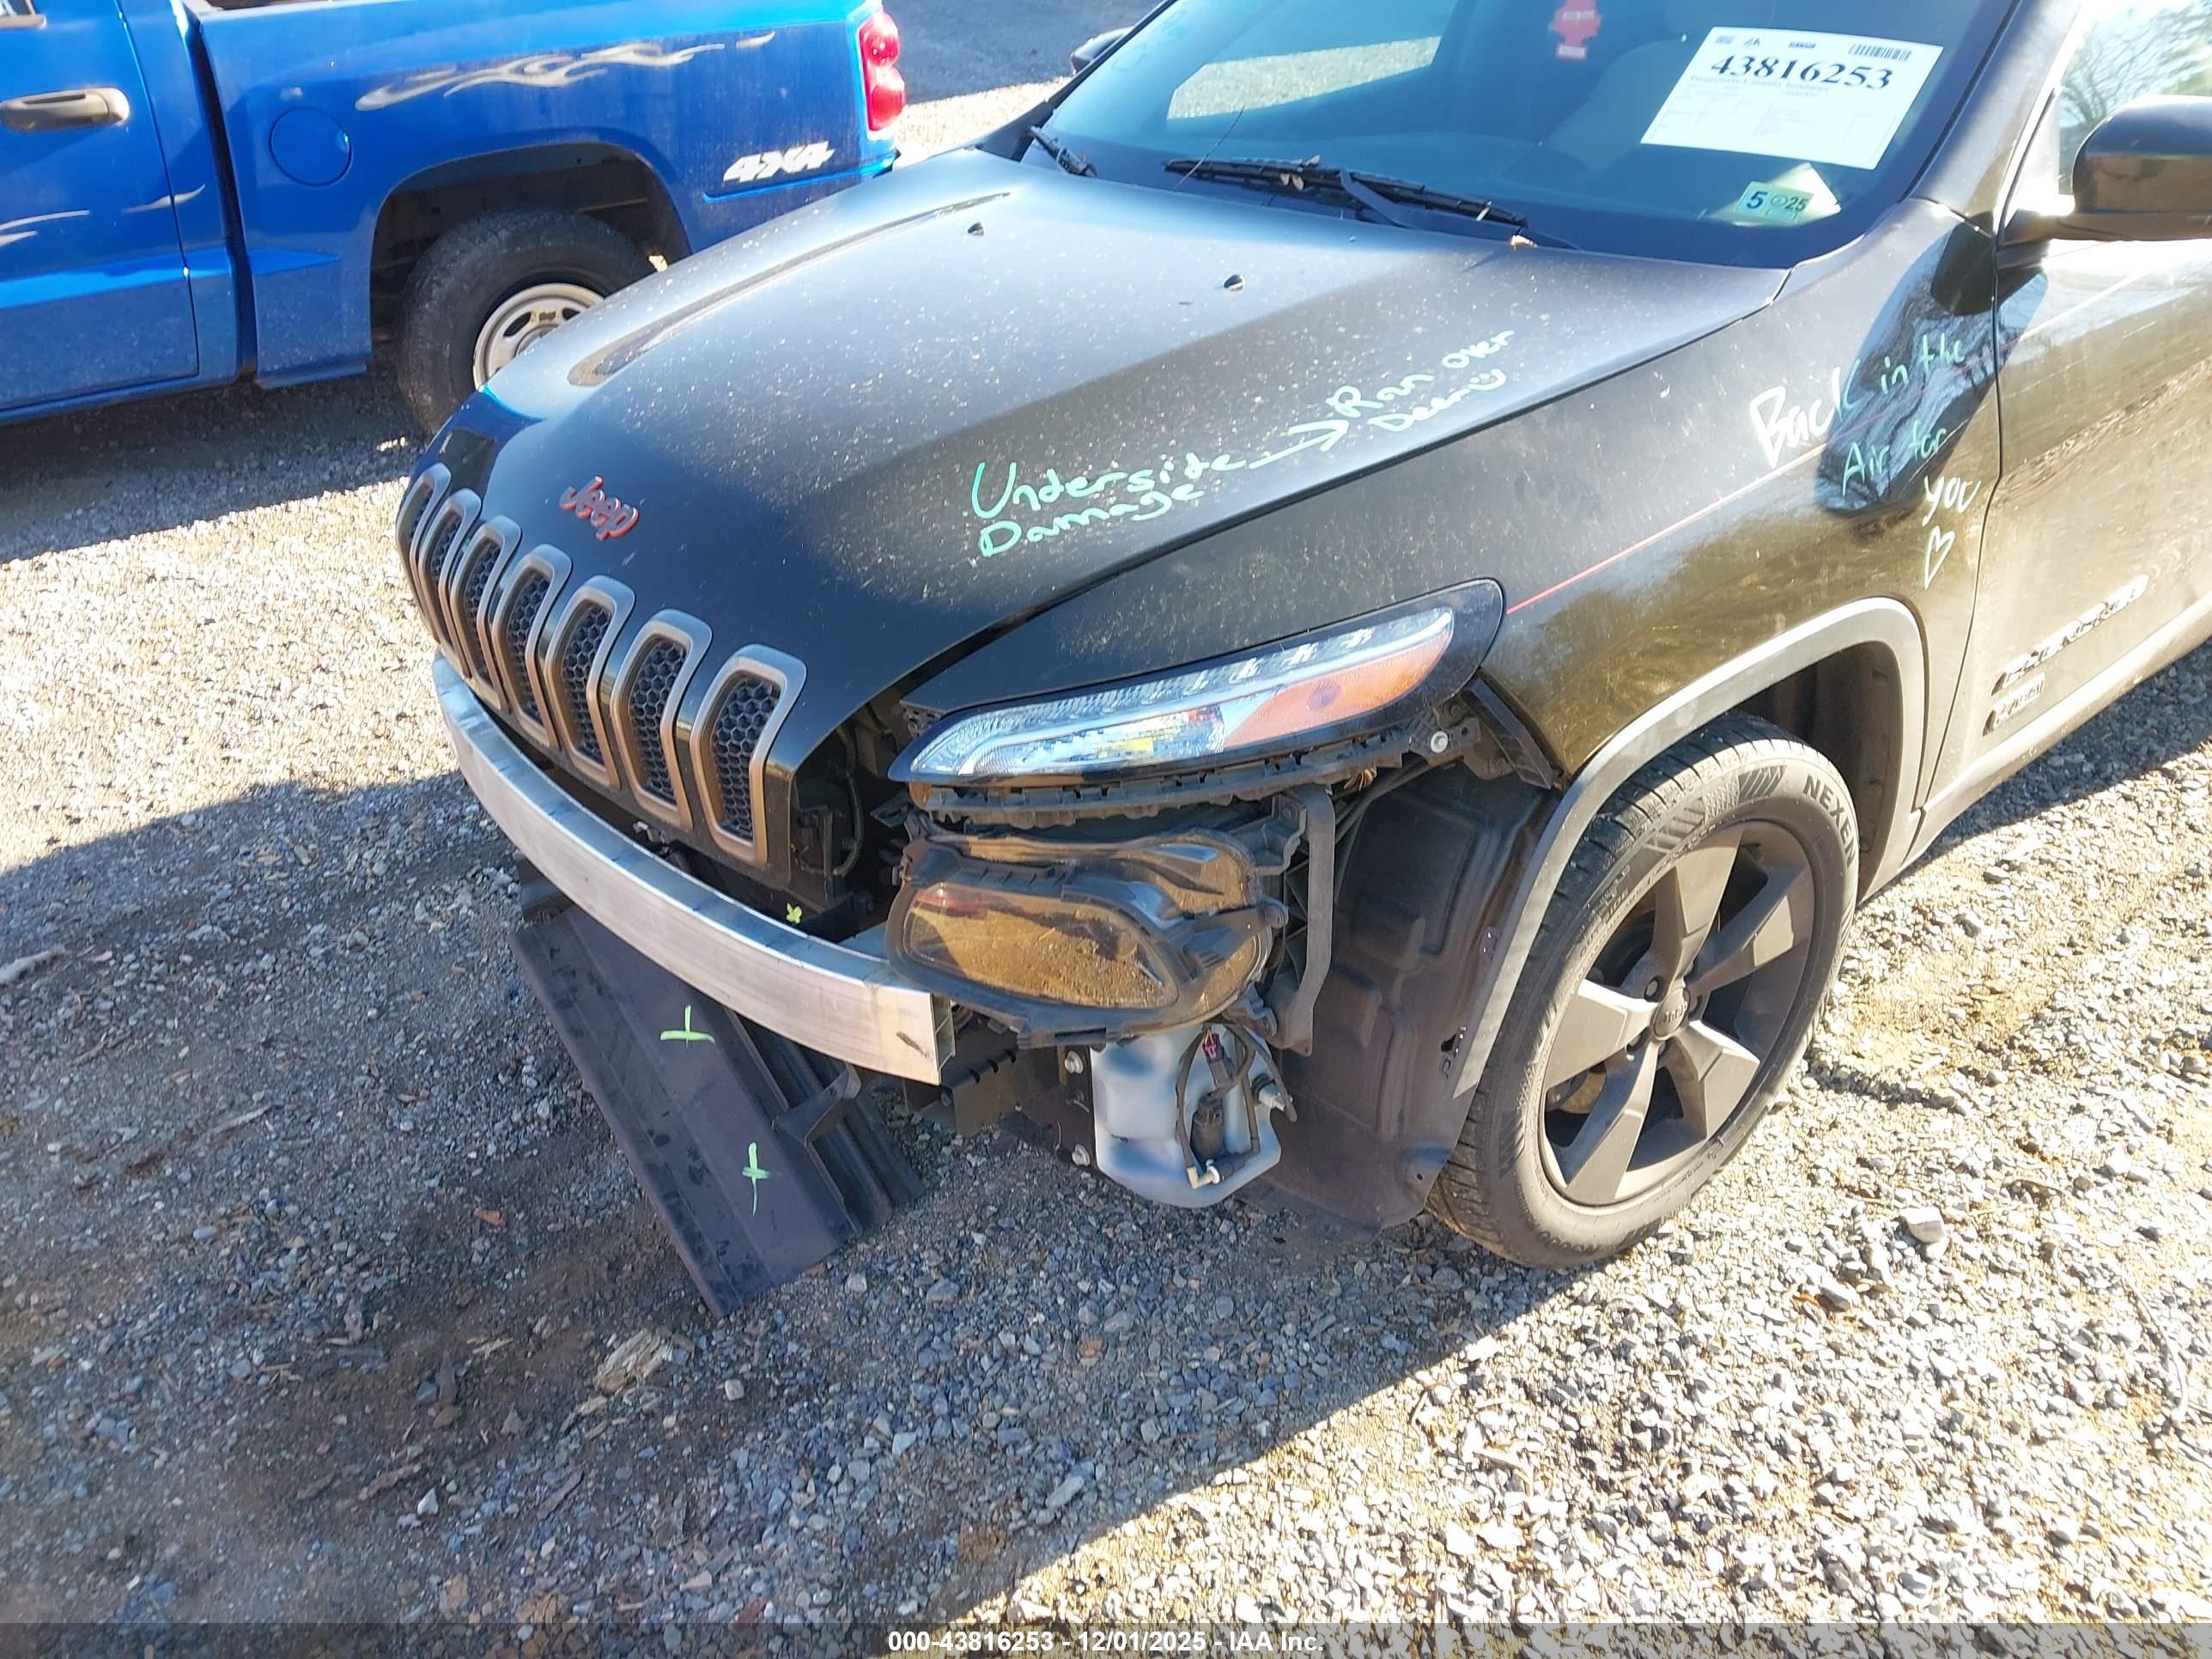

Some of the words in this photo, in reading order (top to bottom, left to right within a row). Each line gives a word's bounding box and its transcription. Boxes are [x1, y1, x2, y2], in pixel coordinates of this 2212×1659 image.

[1711, 54, 1894, 90] 43816253
[1746, 191, 1768, 210] 5
[1784, 197, 1809, 211] 25
[1325, 374, 1434, 417] Ran
[1749, 358, 1861, 468] Back
[1880, 356, 1909, 395] in
[1920, 331, 1966, 366] the
[971, 452, 1247, 519] Underside
[1841, 441, 1890, 496] Air
[558, 475, 639, 541] Jeep
[978, 483, 1205, 557] Damage
[1923, 475, 1981, 527] you
[1802, 774, 1856, 869] NEXEN
